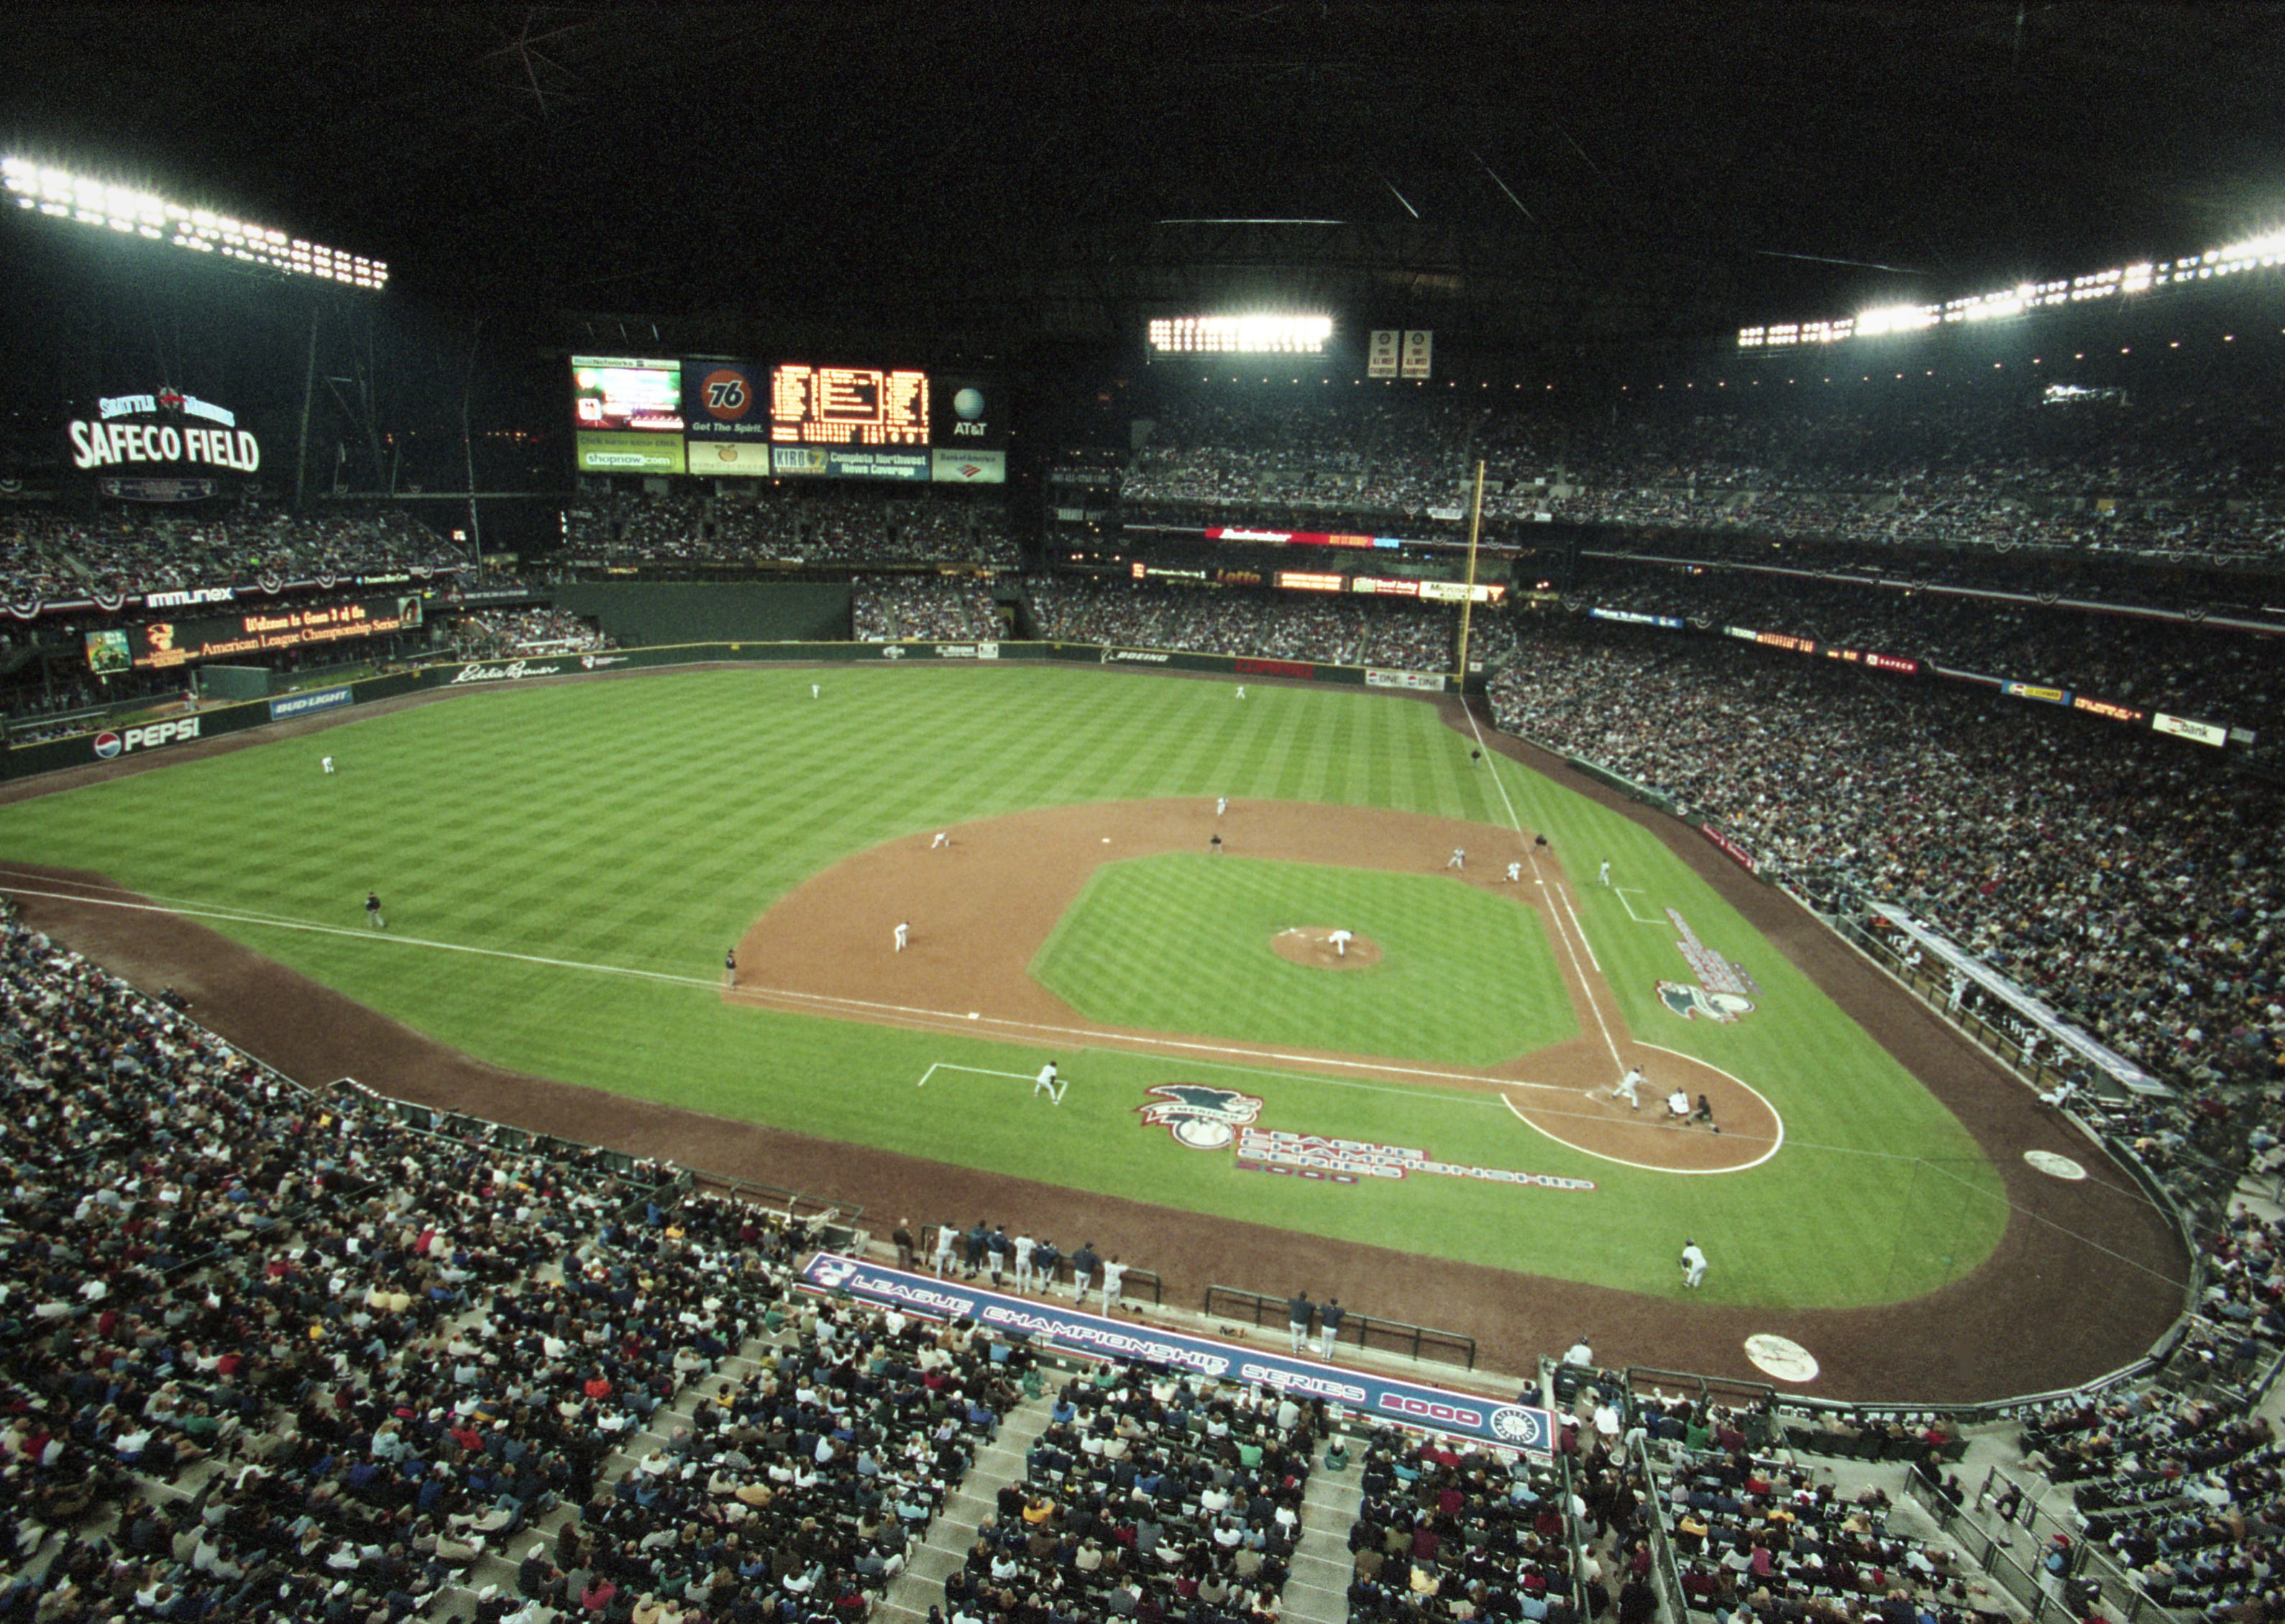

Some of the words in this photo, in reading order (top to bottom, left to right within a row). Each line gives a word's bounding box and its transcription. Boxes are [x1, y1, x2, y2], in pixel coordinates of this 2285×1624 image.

[708, 380, 745, 408] 76
[692, 422, 711, 431] Get
[713, 423, 732, 431] The
[953, 421, 988, 436] AT&T
[70, 420, 181, 469] SAFECO
[183, 428, 260, 472] FIELD
[777, 450, 805, 467] KIRO
[830, 452, 874, 465] Complete
[875, 453, 926, 465] Northwest
[841, 464, 869, 474] News
[871, 464, 915, 477] Coverage
[1217, 568, 1261, 583] Lotto
[201, 637, 259, 656] American
[260, 633, 301, 649] League
[301, 621, 372, 642] Championship
[372, 618, 400, 633] Series
[1116, 651, 1169, 662] BOEING
[1879, 658, 1915, 671] SAFECO
[452, 663, 506, 684] Eddie
[503, 660, 560, 679] Bauer
[275, 699, 308, 715] BUD
[308, 690, 348, 707] LIGHT
[124, 716, 201, 752] PEPSI
[1168, 1106, 1240, 1121] AMERICAN
[1242, 1127, 1429, 1160] LEAGUE
[1236, 1160, 1360, 1185] 2000
[1237, 1147, 1405, 1180] SERIES
[1240, 1137, 1595, 1191] CHAMPIONSHIP
[850, 1274, 975, 1315] LEAGUE
[982, 1305, 1230, 1370] CHAMPIONSHIP
[1241, 1362, 1367, 1403] SERIES
[1378, 1391, 1483, 1428] 2000
